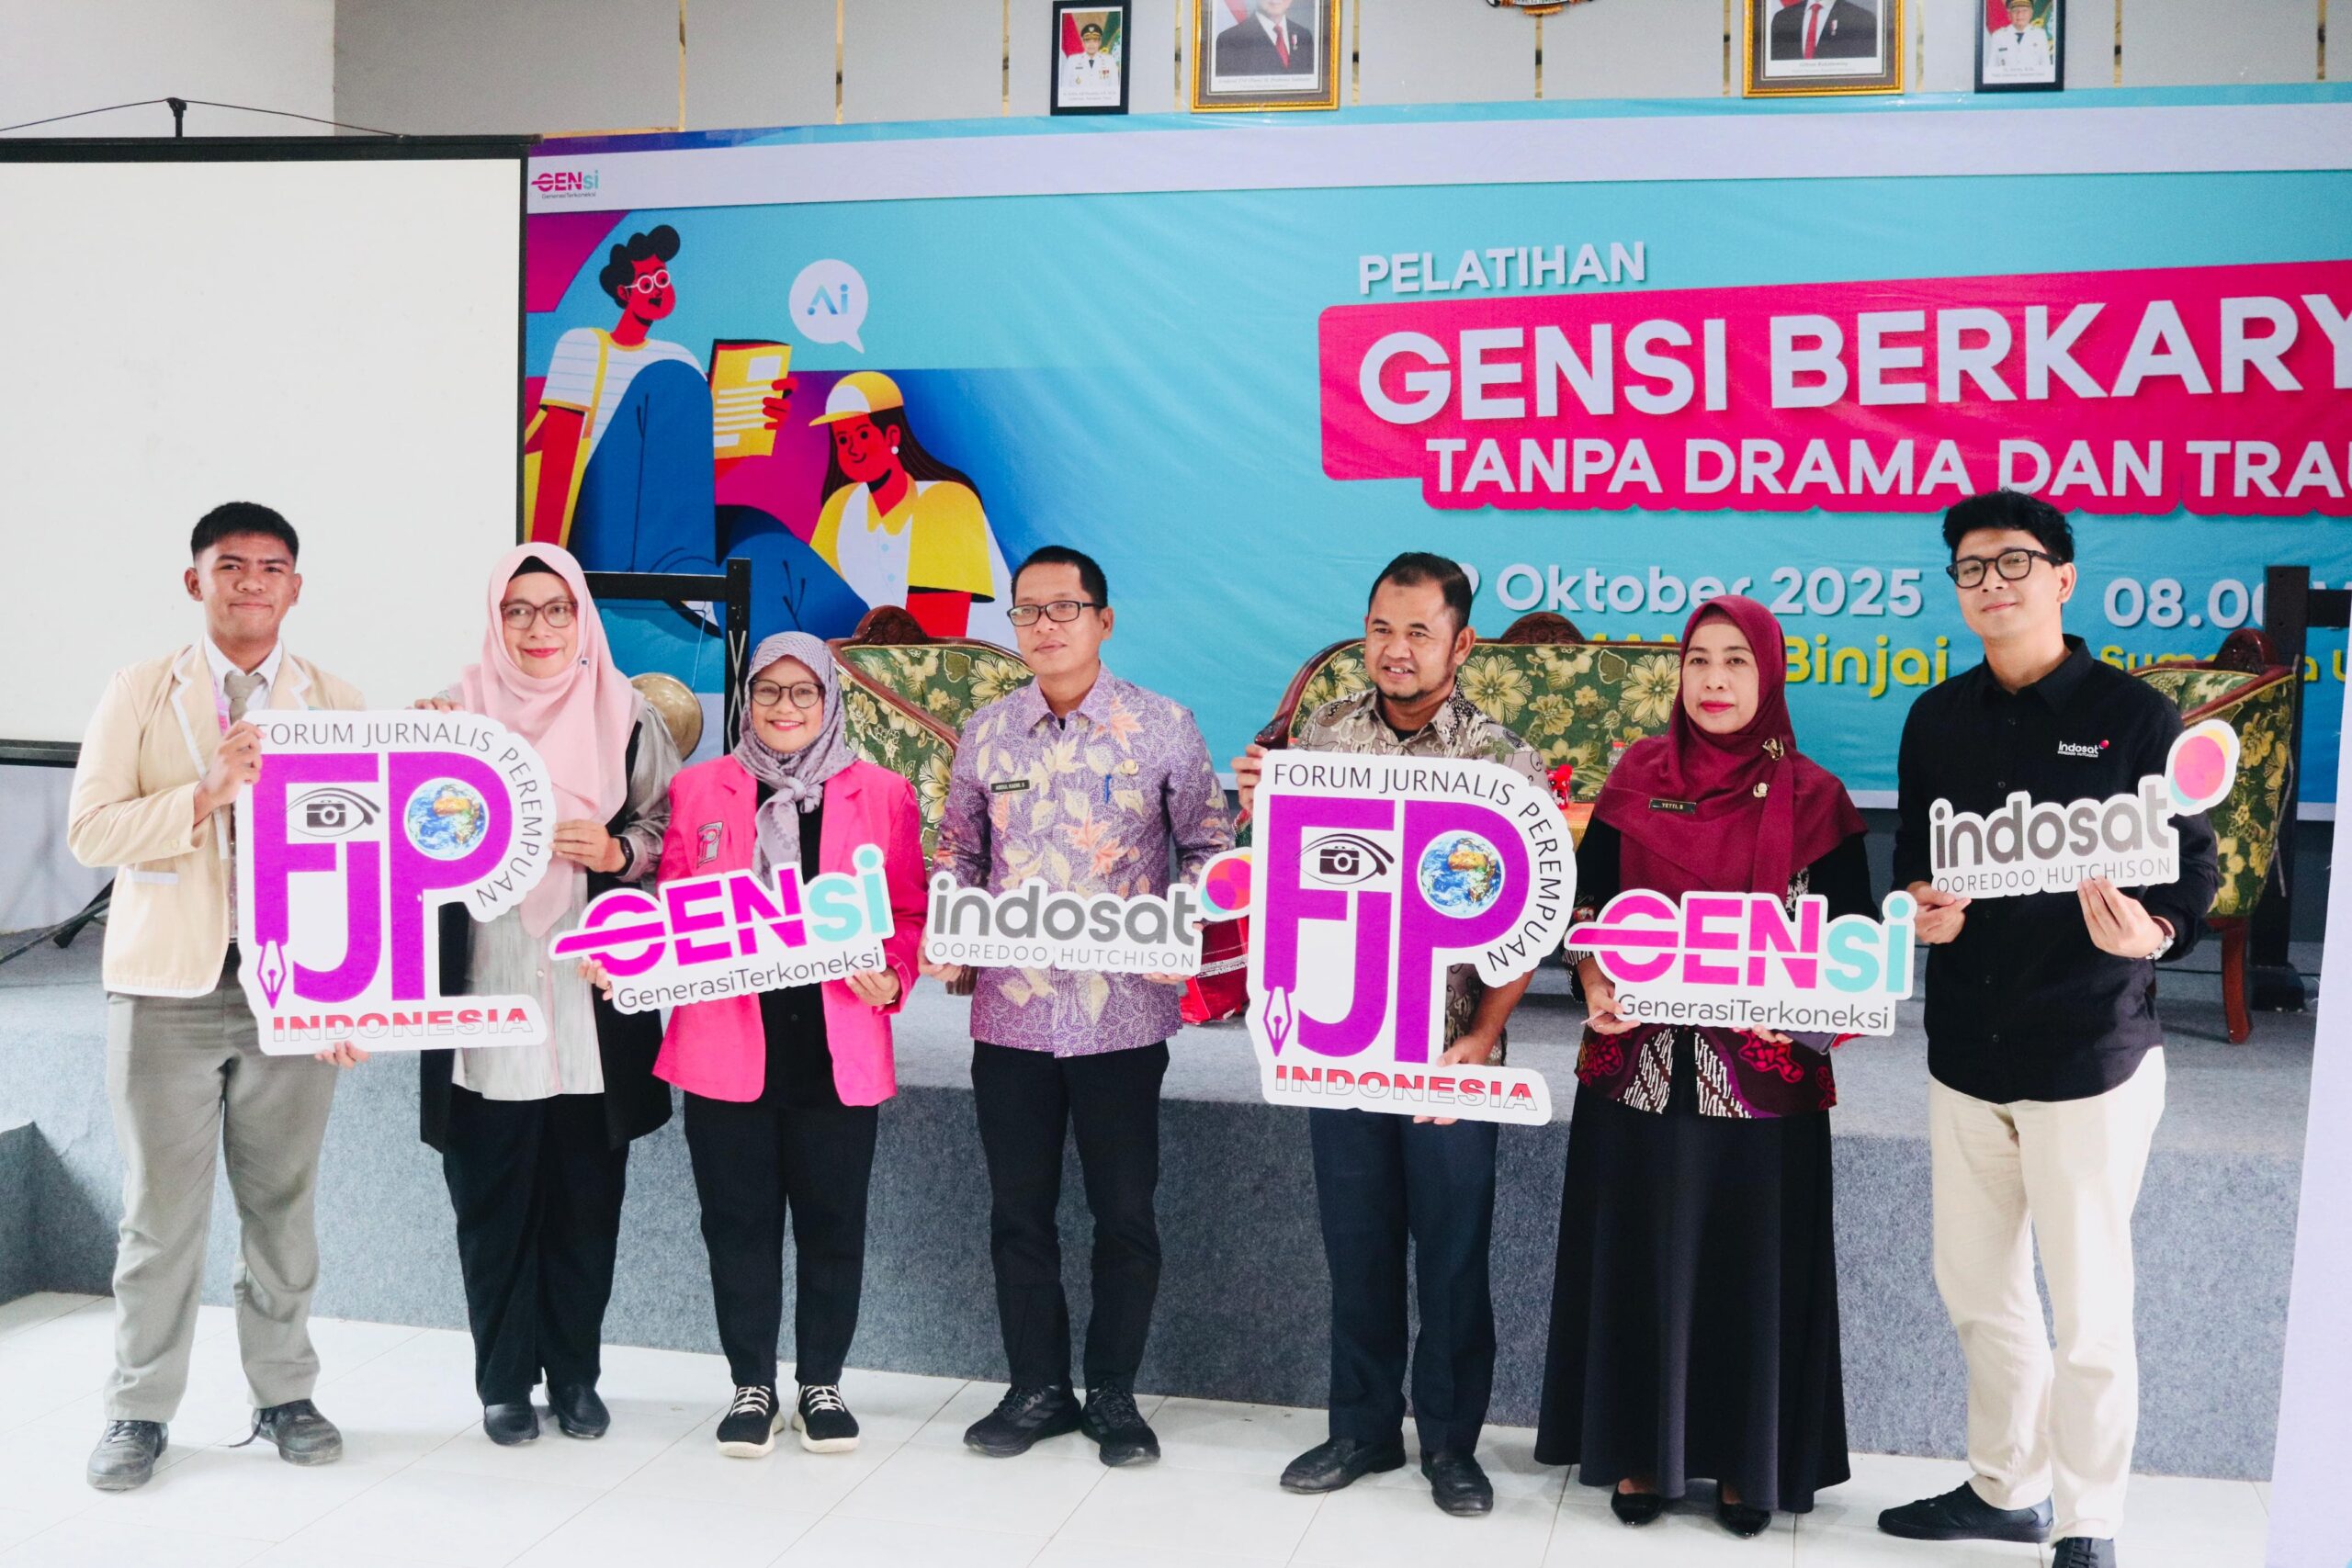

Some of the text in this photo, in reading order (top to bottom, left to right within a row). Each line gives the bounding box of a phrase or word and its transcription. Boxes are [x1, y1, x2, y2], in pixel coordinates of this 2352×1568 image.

[1359, 242, 1645, 295] PELATIHAN
[1359, 293, 2352, 425] GENSI BERKARY
[1426, 438, 2352, 498] TANPA DRAMA DAN TRA
[1770, 566, 1922, 616] 2025
[1785, 634, 1949, 698] Binjai
[256, 723, 354, 747] ORUM
[362, 722, 493, 753] JURNALIS
[476, 747, 543, 908] PEREMPUAN
[1935, 784, 2169, 870] indosat
[253, 751, 513, 1010] FJP
[1274, 763, 1562, 973] FORUM JURNALIS PEREMPUAN
[1936, 856, 2171, 894] OOREDOO HUTCHISON
[933, 877, 1197, 947] indosat
[1262, 795, 1531, 1065] FJP
[618, 946, 882, 1009] GenerasiTerkoneksi
[932, 942, 1194, 969] OOREDOO HUTCHISON
[273, 1007, 534, 1043] INDONESIA
[1618, 994, 1889, 1030] GenerasiTerkoneksi
[1275, 1065, 1537, 1111] INDONESIA
